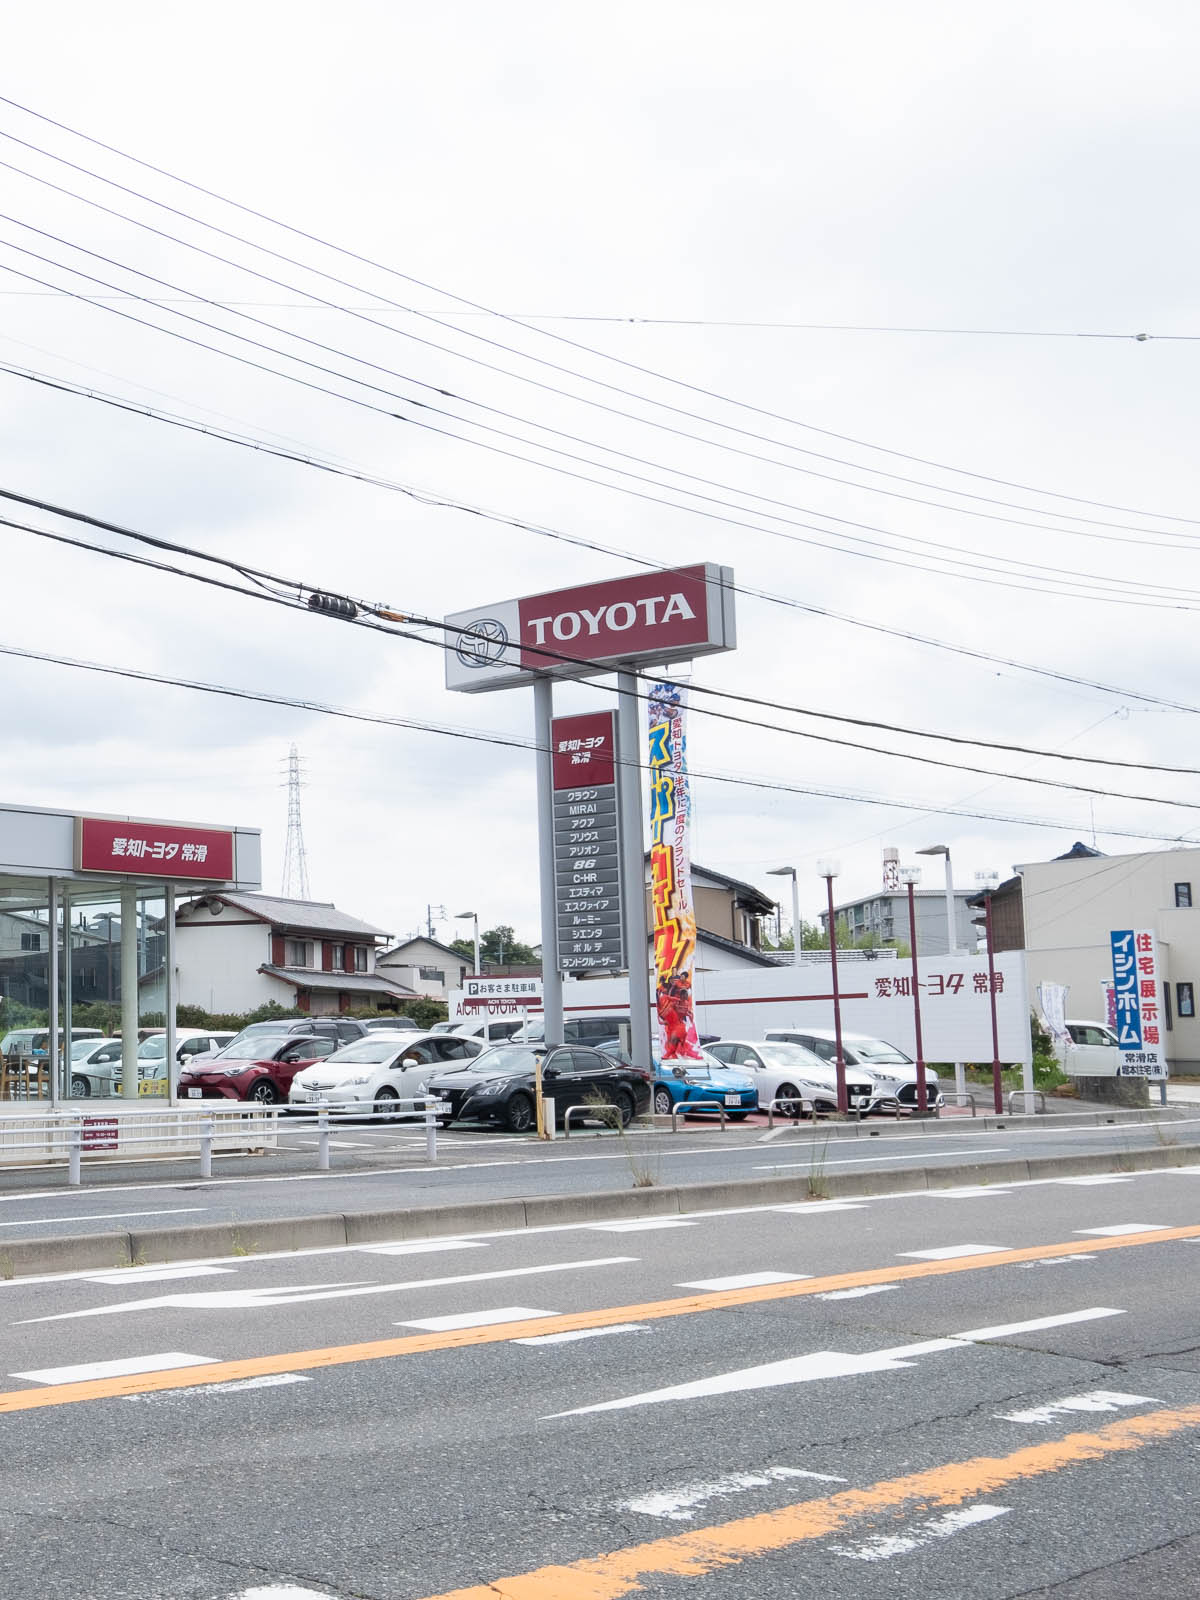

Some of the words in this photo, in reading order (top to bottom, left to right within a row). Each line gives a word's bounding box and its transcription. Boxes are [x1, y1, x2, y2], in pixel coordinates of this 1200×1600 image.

[527, 592, 697, 645] TOYOTA
[557, 736, 606, 753] 愛知トヨタ
[671, 717, 683, 774] 愛知トヨタ
[567, 790, 598, 802] クラウン
[569, 803, 597, 815] MIRAI
[571, 817, 595, 829] アクア
[569, 831, 599, 843] プリウス
[111, 837, 180, 860] 愛知トヨタ
[181, 843, 208, 863] 常滑
[569, 845, 600, 857] アリオン
[573, 859, 597, 870] 86
[573, 873, 597, 883] C-HR
[569, 886, 604, 898] エスティマ
[564, 900, 609, 912] エスクァイア
[573, 915, 601, 925] ルーミー
[572, 928, 603, 939] シエンタ
[573, 942, 603, 953] ポルテ
[562, 956, 617, 968] ランドクルーザー
[480, 983, 536, 993] お客さま駐車場
[1113, 934, 1141, 1045] イシンホーム
[1136, 933, 1160, 1046] 住宅展示場
[487, 1004, 518, 1015] OYOTA
[1124, 1053, 1158, 1064] 常滑店
